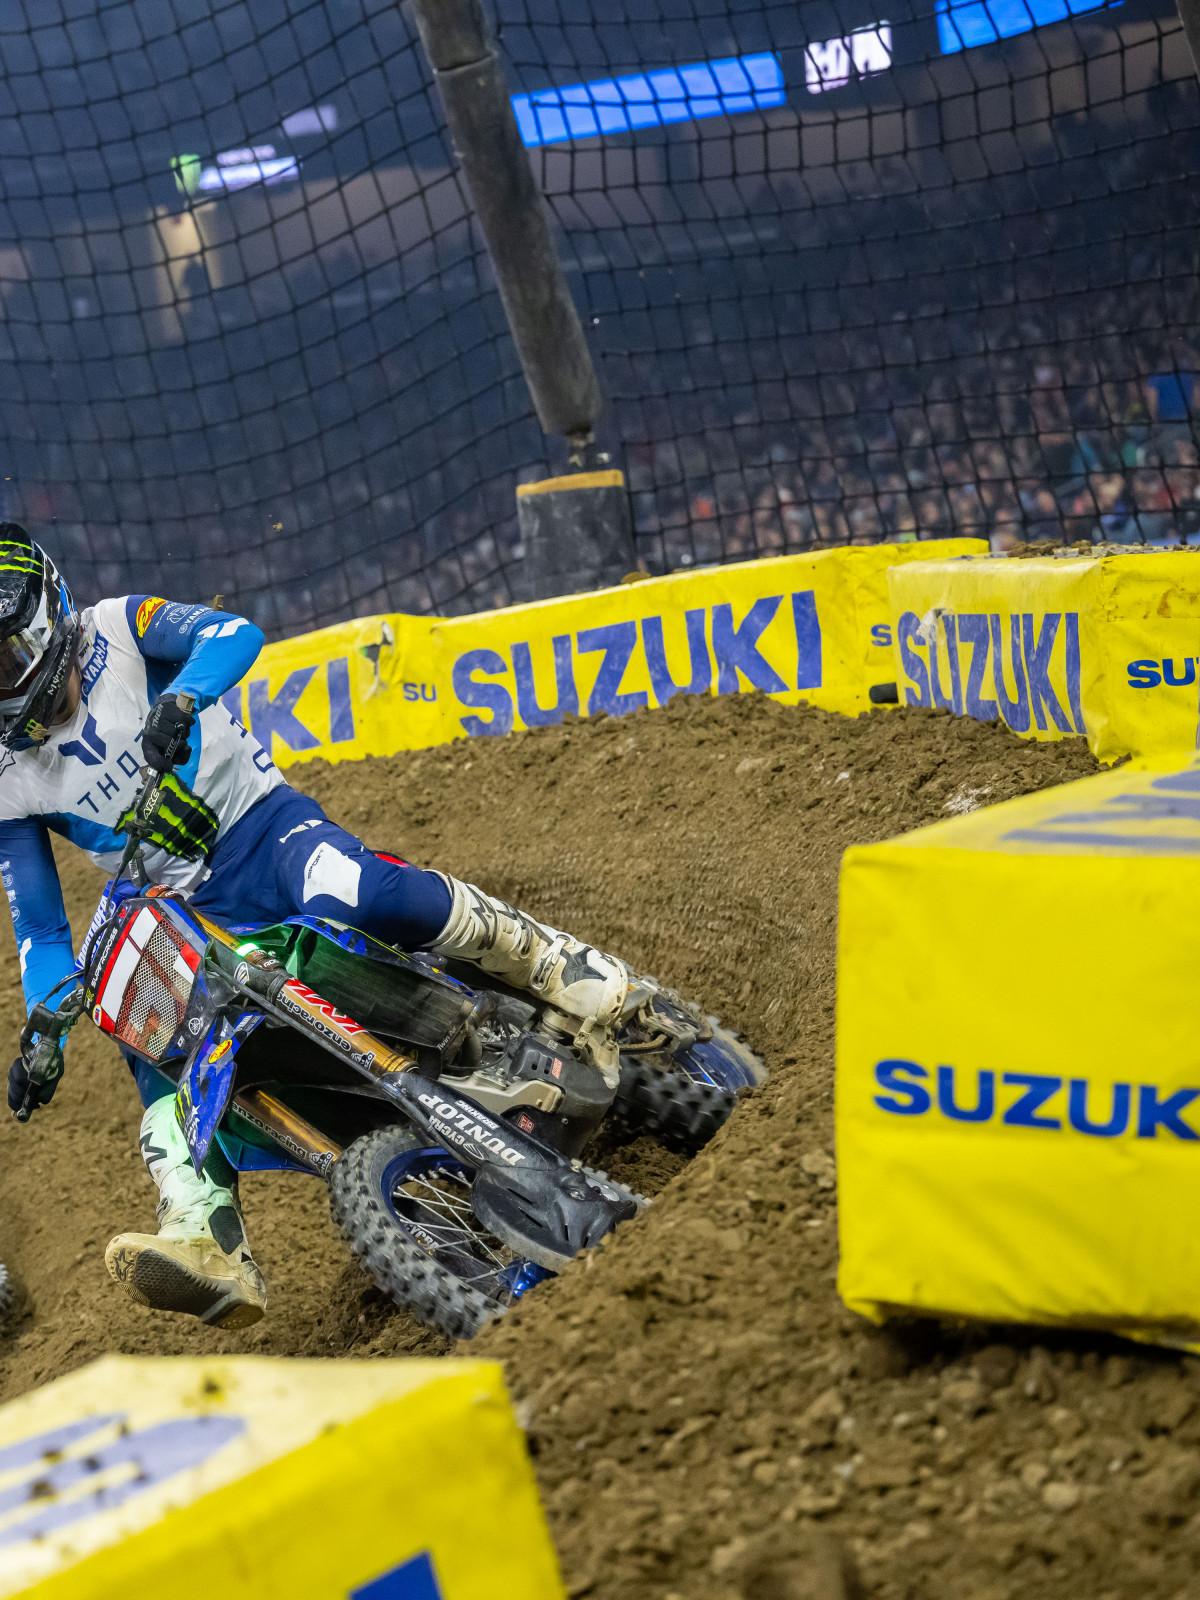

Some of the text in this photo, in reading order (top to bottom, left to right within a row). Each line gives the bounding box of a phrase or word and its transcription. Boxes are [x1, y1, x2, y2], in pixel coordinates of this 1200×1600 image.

[83, 638, 108, 683] YAMAHA
[452, 589, 822, 737] SUZUKI
[898, 611, 1087, 734] SUZUKI
[1127, 656, 1198, 689] SU
[76, 728, 144, 814] THO
[91, 926, 118, 988] SUPERCROSS
[418, 1093, 526, 1166] DUNLOP
[454, 1099, 500, 1130] BRAKING
